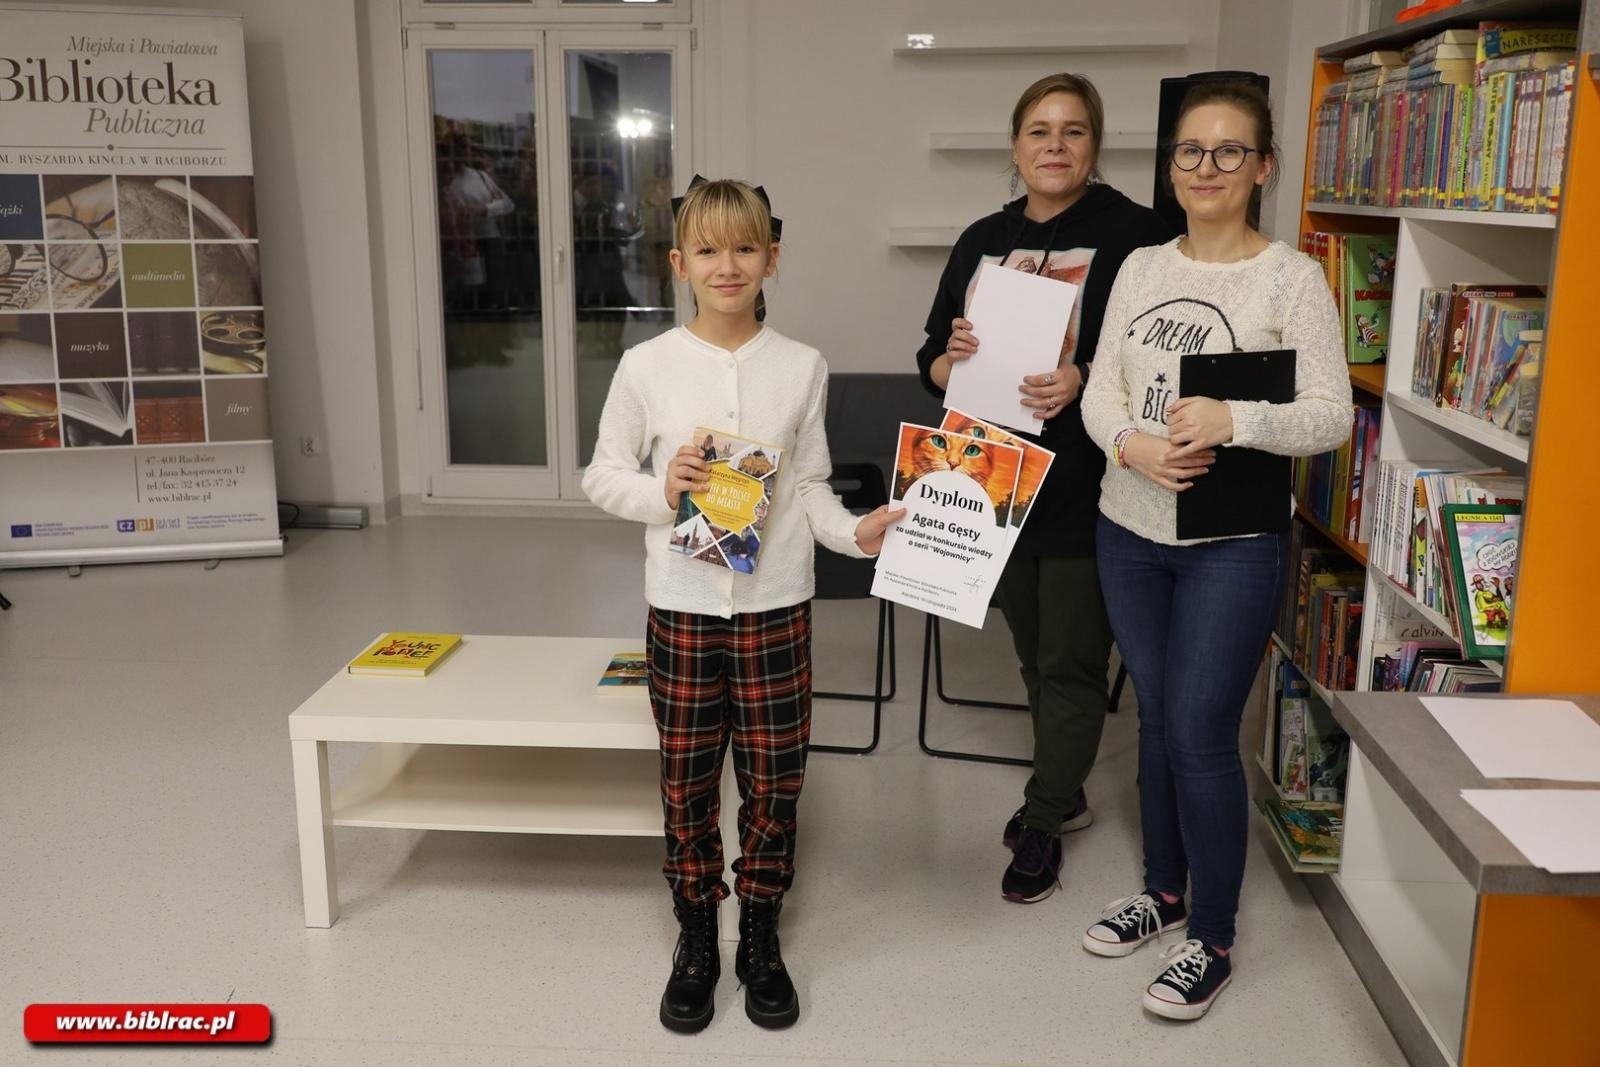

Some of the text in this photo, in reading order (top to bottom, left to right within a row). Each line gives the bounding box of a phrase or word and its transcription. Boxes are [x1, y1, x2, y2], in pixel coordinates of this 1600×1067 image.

[66, 35, 218, 57] Miejska i Powiatowa
[0, 57, 221, 106] Biblioteka
[83, 107, 206, 138] Publiczna
[19, 154, 84, 165] RYSZARDA
[88, 155, 136, 165] KINCLA
[140, 156, 148, 165] W
[155, 156, 226, 166] RACIBORZU
[0, 203, 24, 218] ążki
[131, 270, 186, 282] multimedia
[1142, 317, 1213, 355] DREAM
[70, 341, 110, 354] muzyka
[225, 402, 252, 416] filmy
[159, 468, 179, 478] Jana
[235, 465, 245, 474] 12
[920, 483, 984, 513] Dyplom
[912, 513, 981, 542] Agata Gęsty
[905, 527, 926, 539] udział
[933, 535, 967, 551] konkursie
[968, 546, 993, 560] wiedzy
[914, 541, 929, 550] serii
